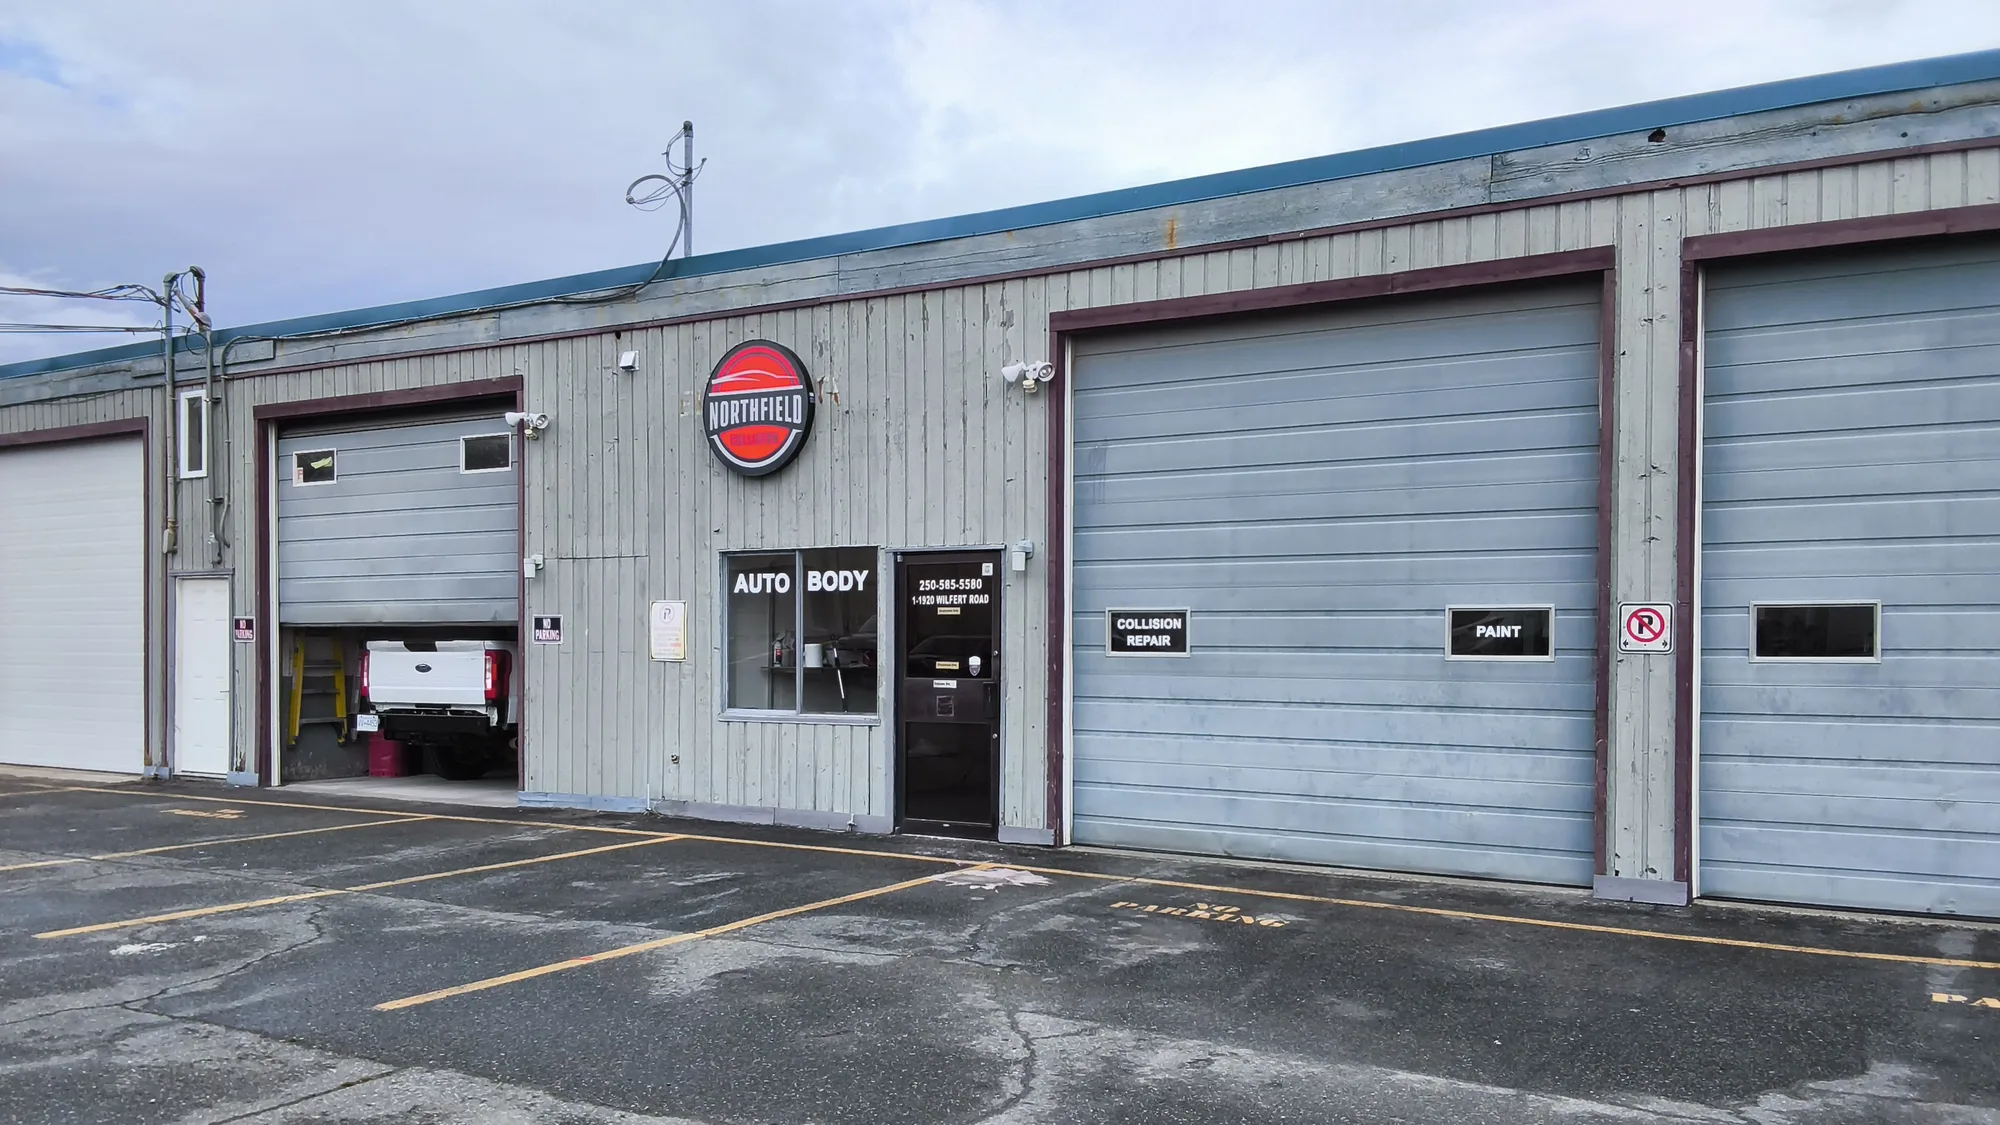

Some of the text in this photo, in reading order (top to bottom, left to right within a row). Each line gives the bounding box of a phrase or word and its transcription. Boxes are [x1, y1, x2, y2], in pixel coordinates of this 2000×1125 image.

[709, 395, 802, 431] NORTHFIELD
[734, 570, 869, 594] AUTO BODY
[919, 578, 982, 591] 250-585-5580
[912, 594, 989, 605] 1-1920 WILFERT ROAD
[542, 618, 551, 629] NO
[1117, 618, 1182, 630] COLLISION
[535, 629, 560, 641] PARKING
[1476, 625, 1521, 638] PAINT
[1126, 635, 1171, 646] REPAIR
[1109, 901, 1291, 928] PARKING
